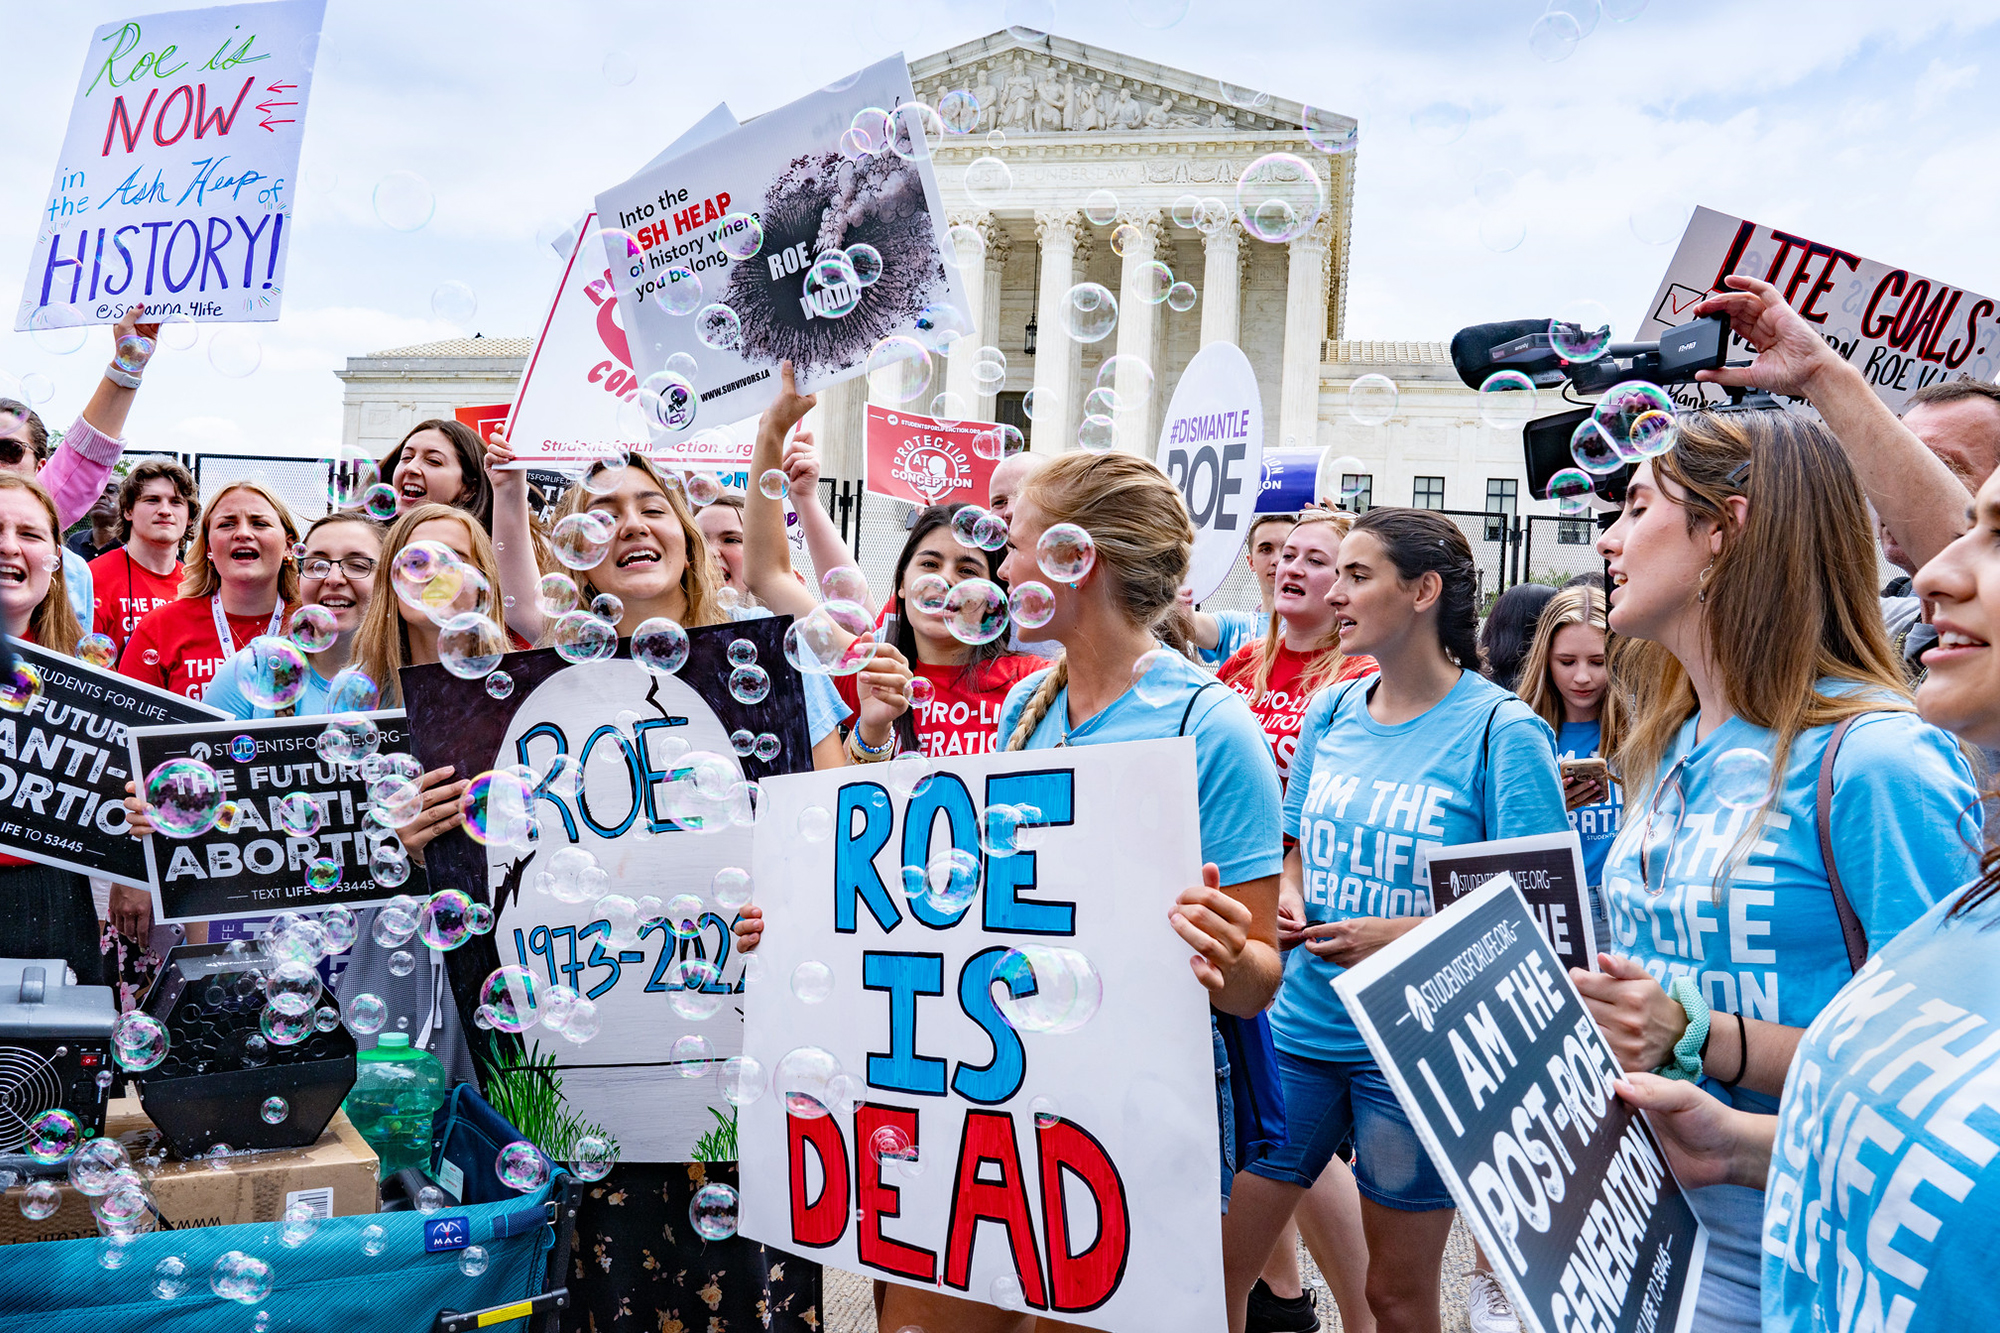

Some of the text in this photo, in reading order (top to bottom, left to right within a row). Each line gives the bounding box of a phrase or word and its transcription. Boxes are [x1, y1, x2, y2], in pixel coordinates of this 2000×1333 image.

[85, 22, 271, 97] Roe is
[102, 76, 255, 156] NOW
[48, 156, 284, 221] the Ash Heap of
[61, 167, 85, 191] in
[938, 173, 957, 183] AL
[1034, 167, 1089, 182] UNDER
[1097, 167, 1129, 181] LAW
[619, 188, 689, 228] Into the
[626, 191, 732, 258] ASH HEAP
[40, 213, 283, 306] HISTORY!
[630, 212, 761, 278] of history where
[767, 241, 812, 281] ROE
[636, 276, 666, 302] you
[669, 251, 728, 284] belong
[799, 281, 862, 320] WADE
[700, 368, 771, 402] WWW.SURVIVORS.LA
[1863, 345, 1915, 391] ROE
[1170, 409, 1249, 444] #DISMANTLE
[891, 468, 973, 489] CONCEPTION
[893, 434, 971, 474] PROTECTION
[912, 453, 929, 467] AT
[120, 597, 149, 613] THE
[30, 662, 103, 699] STUDENTS
[104, 690, 136, 711] FOR
[138, 701, 169, 722] LIFE
[921, 700, 1000, 726] PRO-LI
[23, 693, 129, 748] FUTUR
[0, 763, 137, 837] RTIO
[168, 768, 238, 796] THE
[249, 756, 380, 790] FUTURE
[516, 716, 703, 844] ROE
[227, 789, 374, 835] ANTI-
[1366, 780, 1453, 837] THE
[0, 821, 84, 853] IFE TO 53445
[164, 830, 409, 882] ABORTIO
[835, 767, 1076, 936] ROE
[1300, 816, 1443, 887] RO-LIFE
[1669, 808, 1792, 882] THE
[251, 888, 281, 900] TEXT
[285, 885, 311, 897] LIFE
[336, 880, 376, 893] 53445
[1528, 903, 1572, 955] HE
[1609, 877, 1776, 964] O-LIFE
[1420, 919, 1518, 1013] STUDENTSFORLIFE.ORG
[863, 945, 1038, 1105] IS
[1416, 949, 1566, 1138] I AM THE
[1848, 997, 2000, 1168] THE
[1467, 1014, 1617, 1277] POST-ROE
[785, 1091, 1131, 1313] DEAD
[1551, 1115, 1666, 1333] GENERATION
[433, 1235, 463, 1246] MAC
[1647, 1277, 1663, 1307] TO
